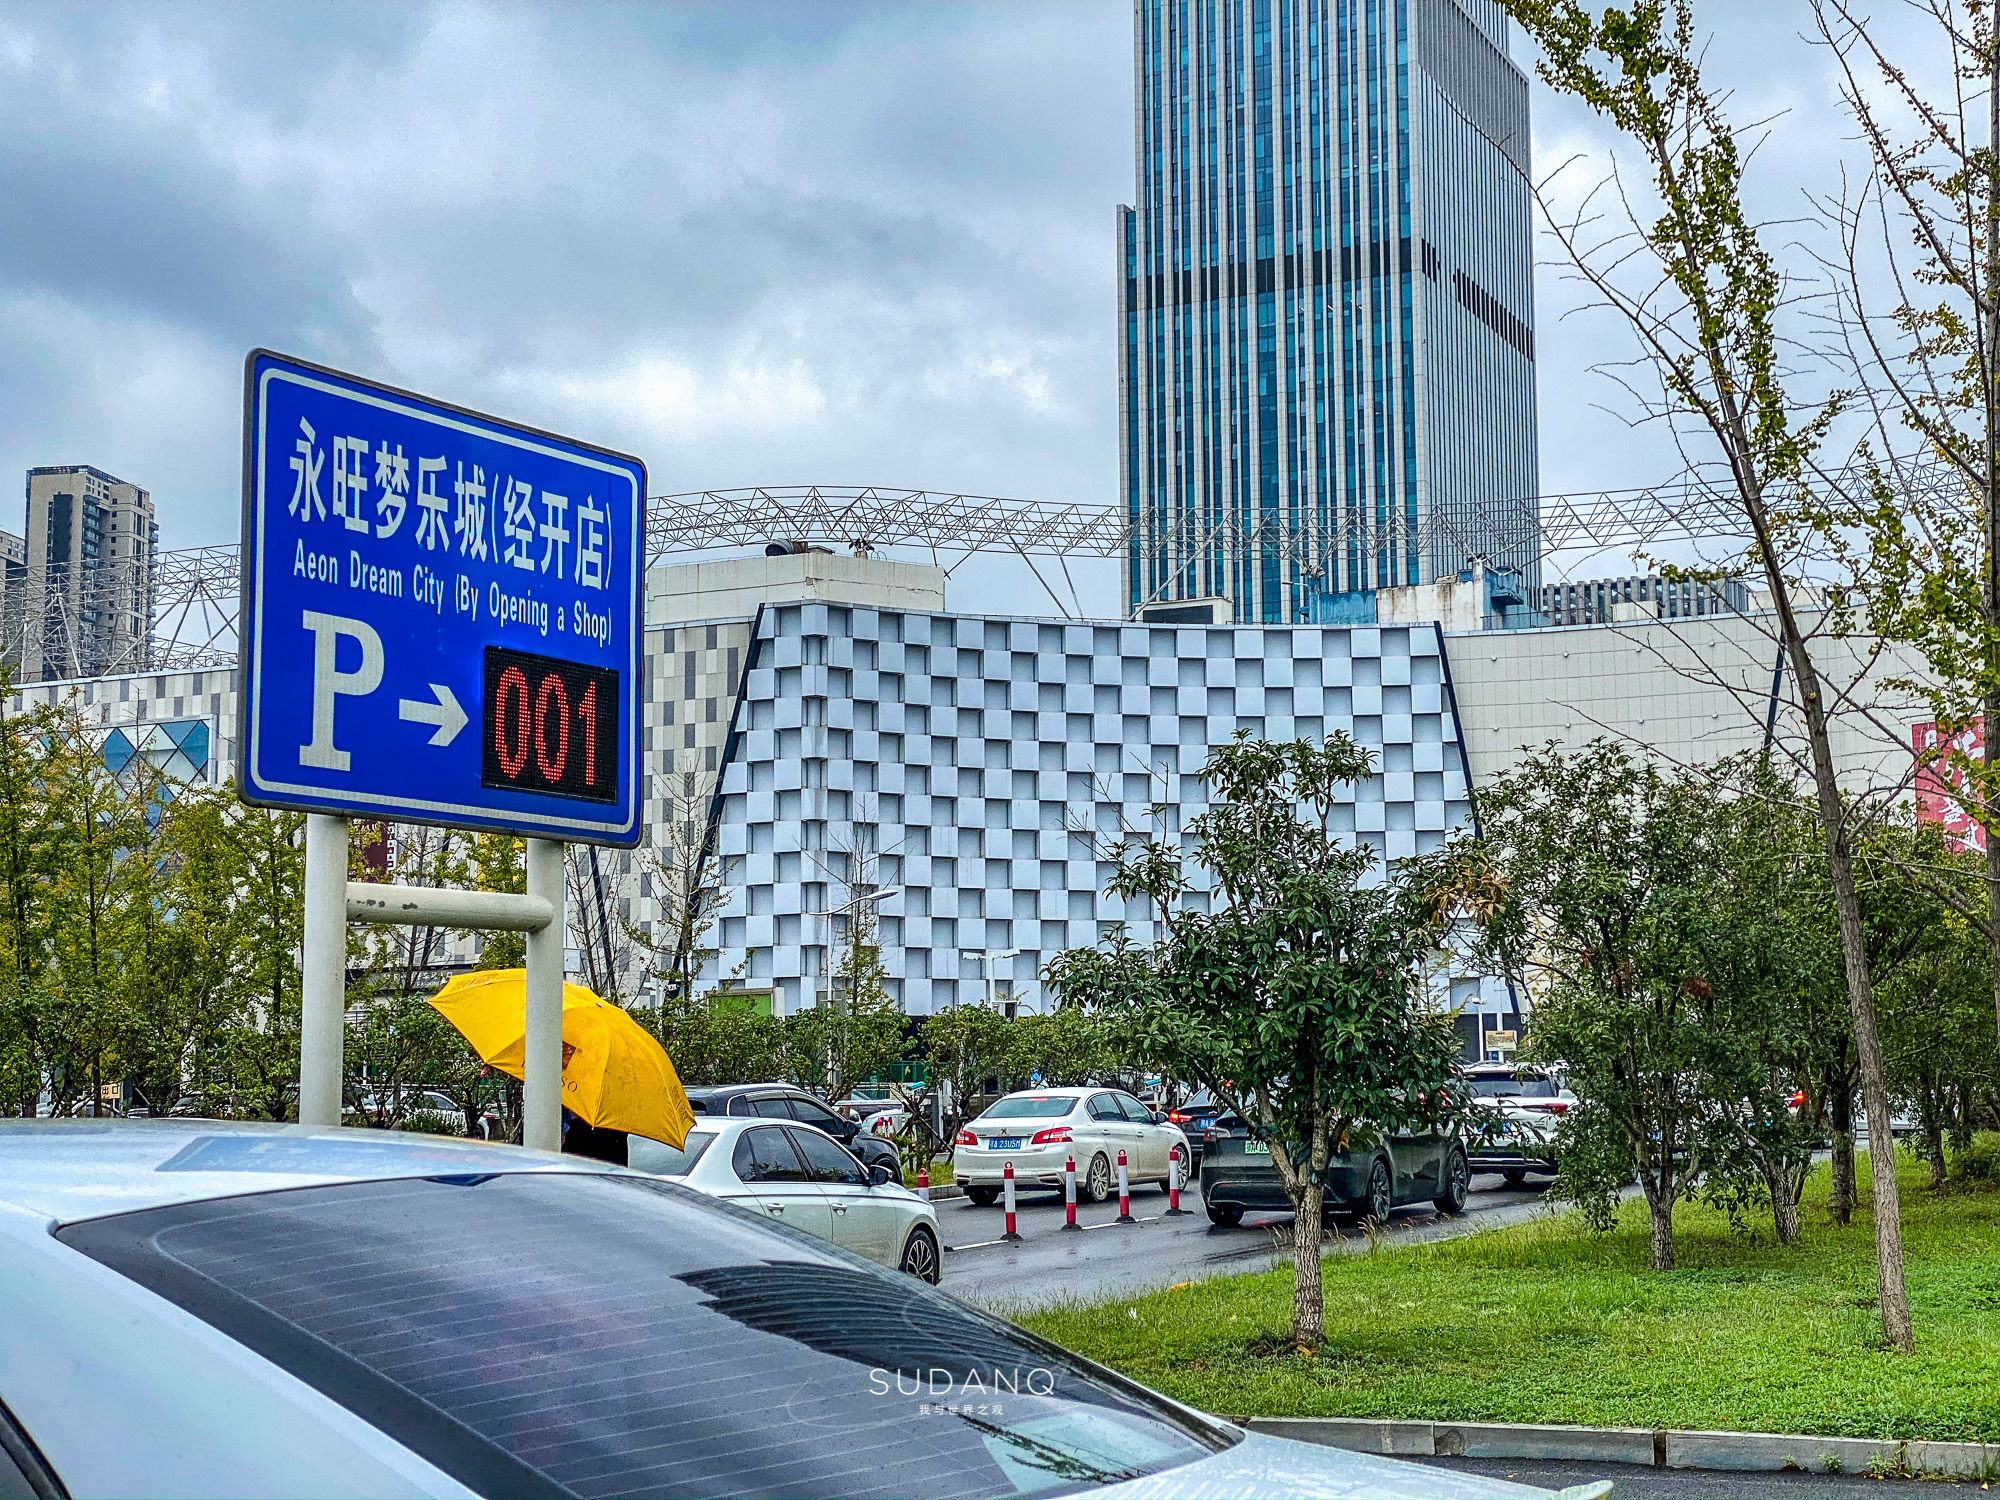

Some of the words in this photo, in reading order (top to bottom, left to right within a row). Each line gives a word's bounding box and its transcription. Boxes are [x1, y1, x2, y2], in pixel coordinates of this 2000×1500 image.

[293, 538, 338, 584] Aeon
[350, 550, 402, 598] Dream
[413, 564, 444, 615] City
[455, 573, 479, 622] (By
[489, 581, 548, 637] Opening
[557, 606, 565, 632] a
[573, 600, 612, 648] Shop)
[299, 609, 386, 773] P
[495, 666, 598, 787] 001
